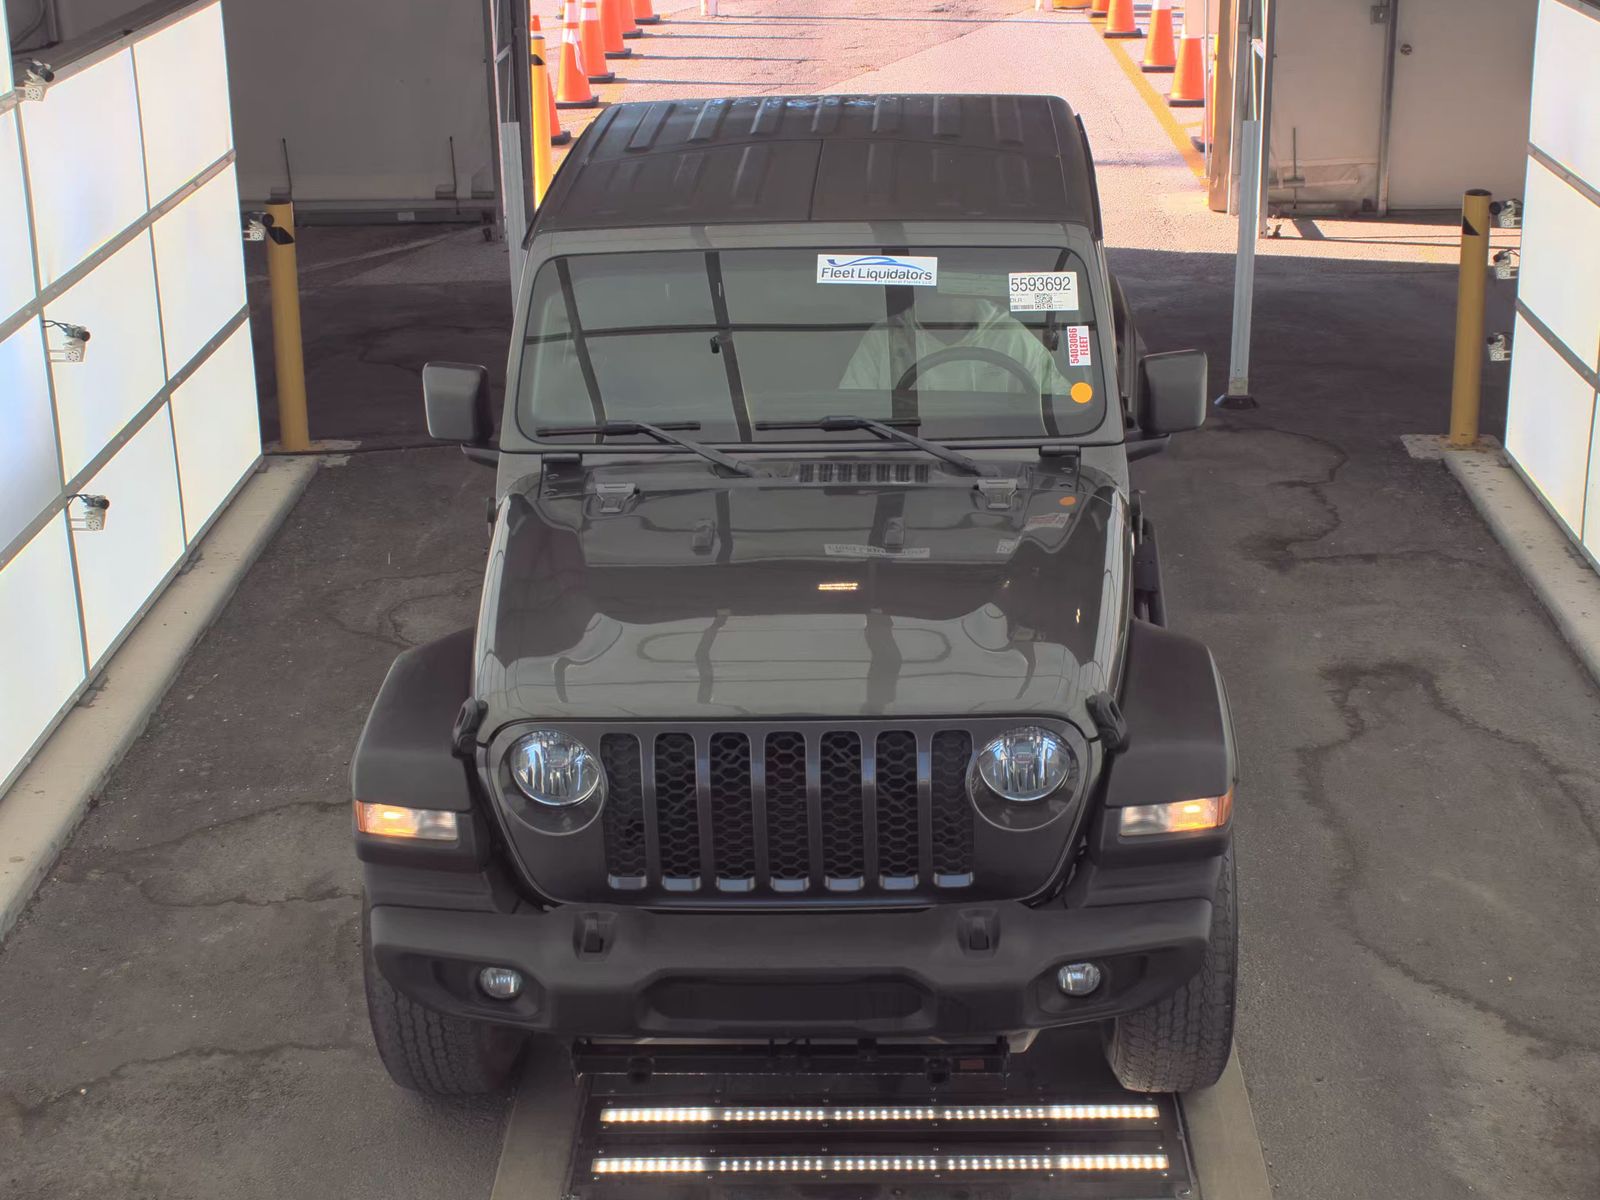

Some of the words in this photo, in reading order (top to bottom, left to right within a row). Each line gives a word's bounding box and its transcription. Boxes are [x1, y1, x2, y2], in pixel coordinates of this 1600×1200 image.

[821, 267, 855, 279] Fleet
[858, 268, 933, 282] Liquidators
[1011, 276, 1072, 292] 5593692
[1069, 327, 1080, 365] 5403066
[1079, 335, 1089, 356] FLEET
